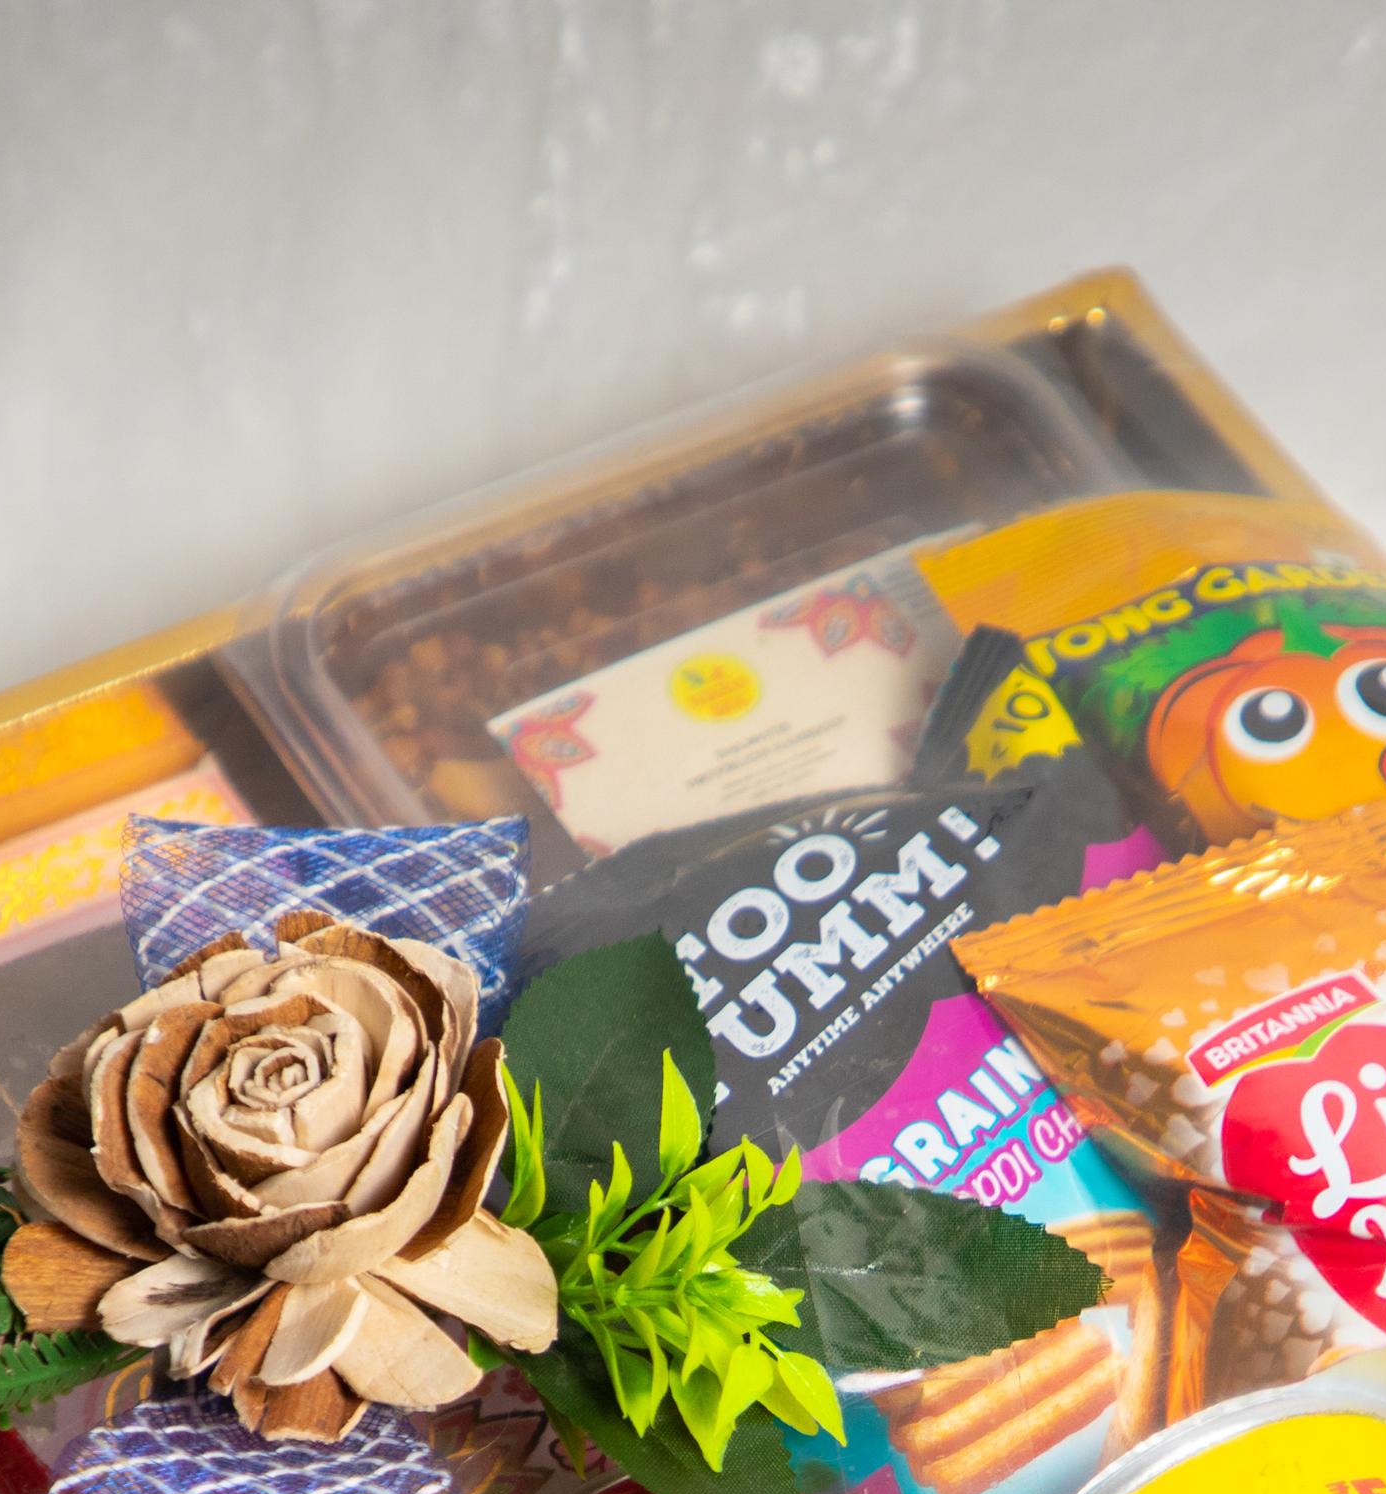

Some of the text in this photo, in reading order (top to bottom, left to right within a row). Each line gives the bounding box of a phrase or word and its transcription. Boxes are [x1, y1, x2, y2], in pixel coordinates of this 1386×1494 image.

[1023, 589, 1193, 679] TONG
[706, 806, 1000, 1106] UMM!
[766, 903, 975, 1096] ANYTIME ANYWHERE
[1204, 985, 1357, 1071] BRITANNIA
